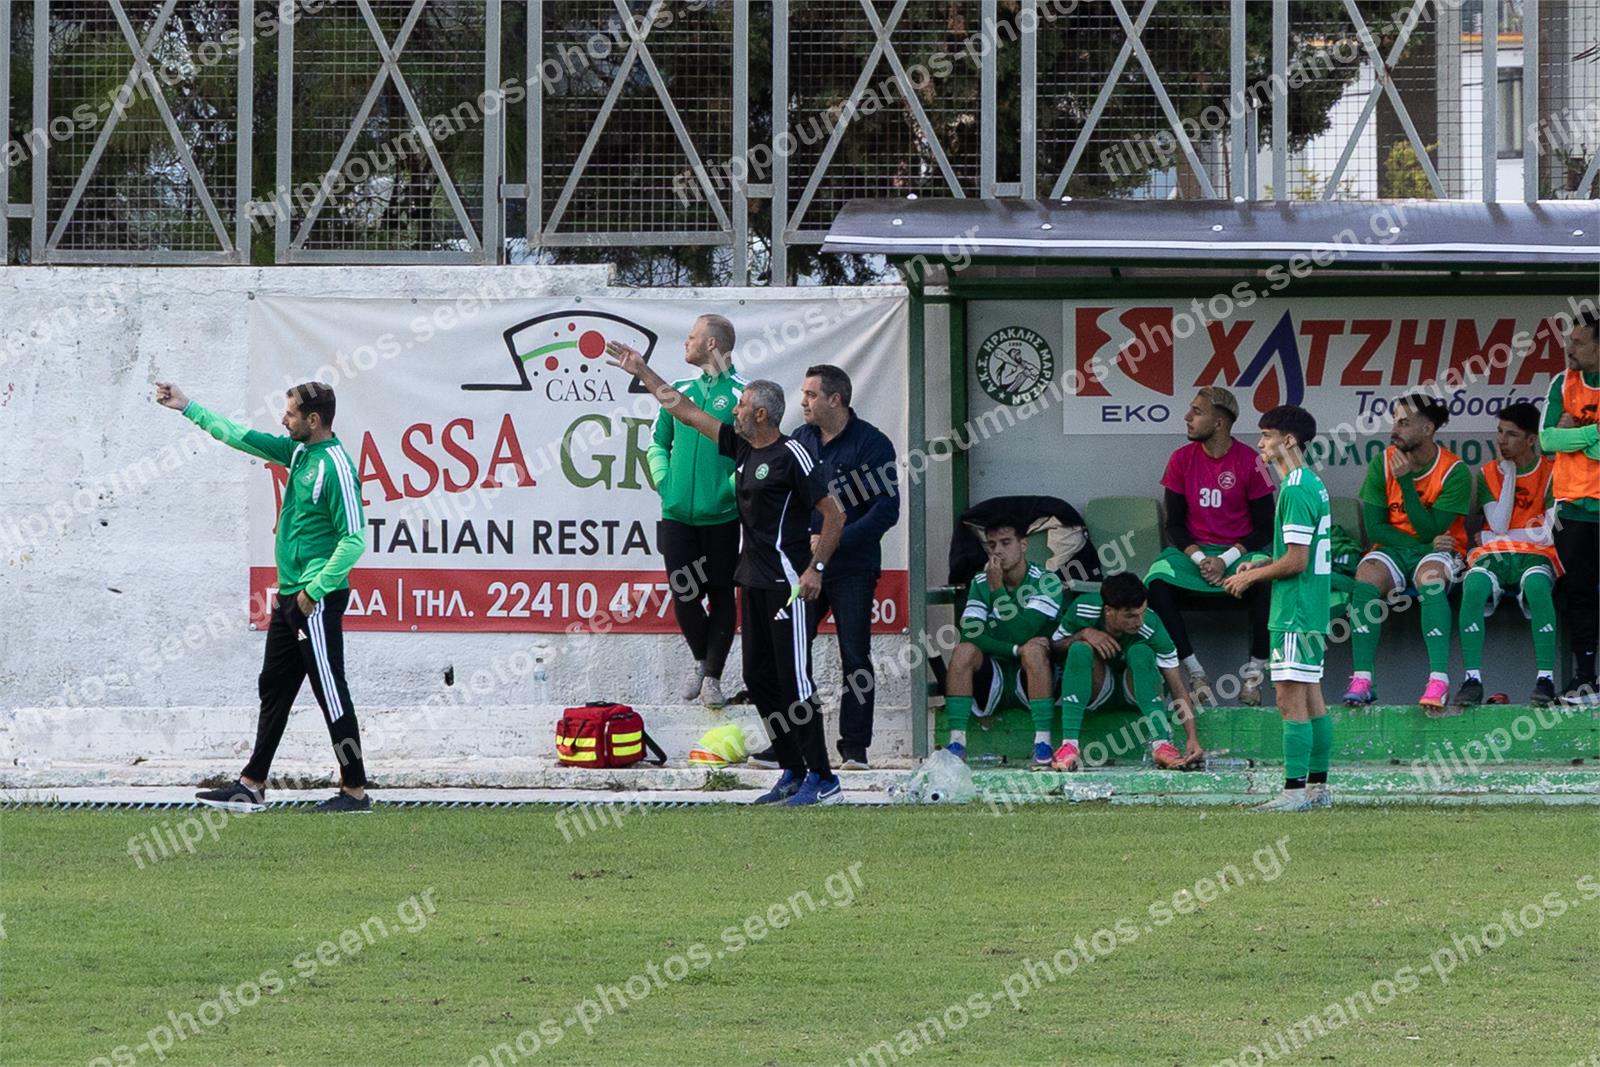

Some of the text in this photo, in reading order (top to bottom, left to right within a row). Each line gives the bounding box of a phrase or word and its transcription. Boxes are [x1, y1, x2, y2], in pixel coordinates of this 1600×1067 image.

[983, 328, 1043, 352] ΗΡΑΚΛΗΣ
[546, 379, 616, 402] CASA
[1101, 404, 1170, 423] EKO
[1199, 487, 1222, 508] 30
[412, 590, 475, 617] ΤΗΛ.
[486, 581, 598, 618] 22410
[608, 582, 672, 618] 477
